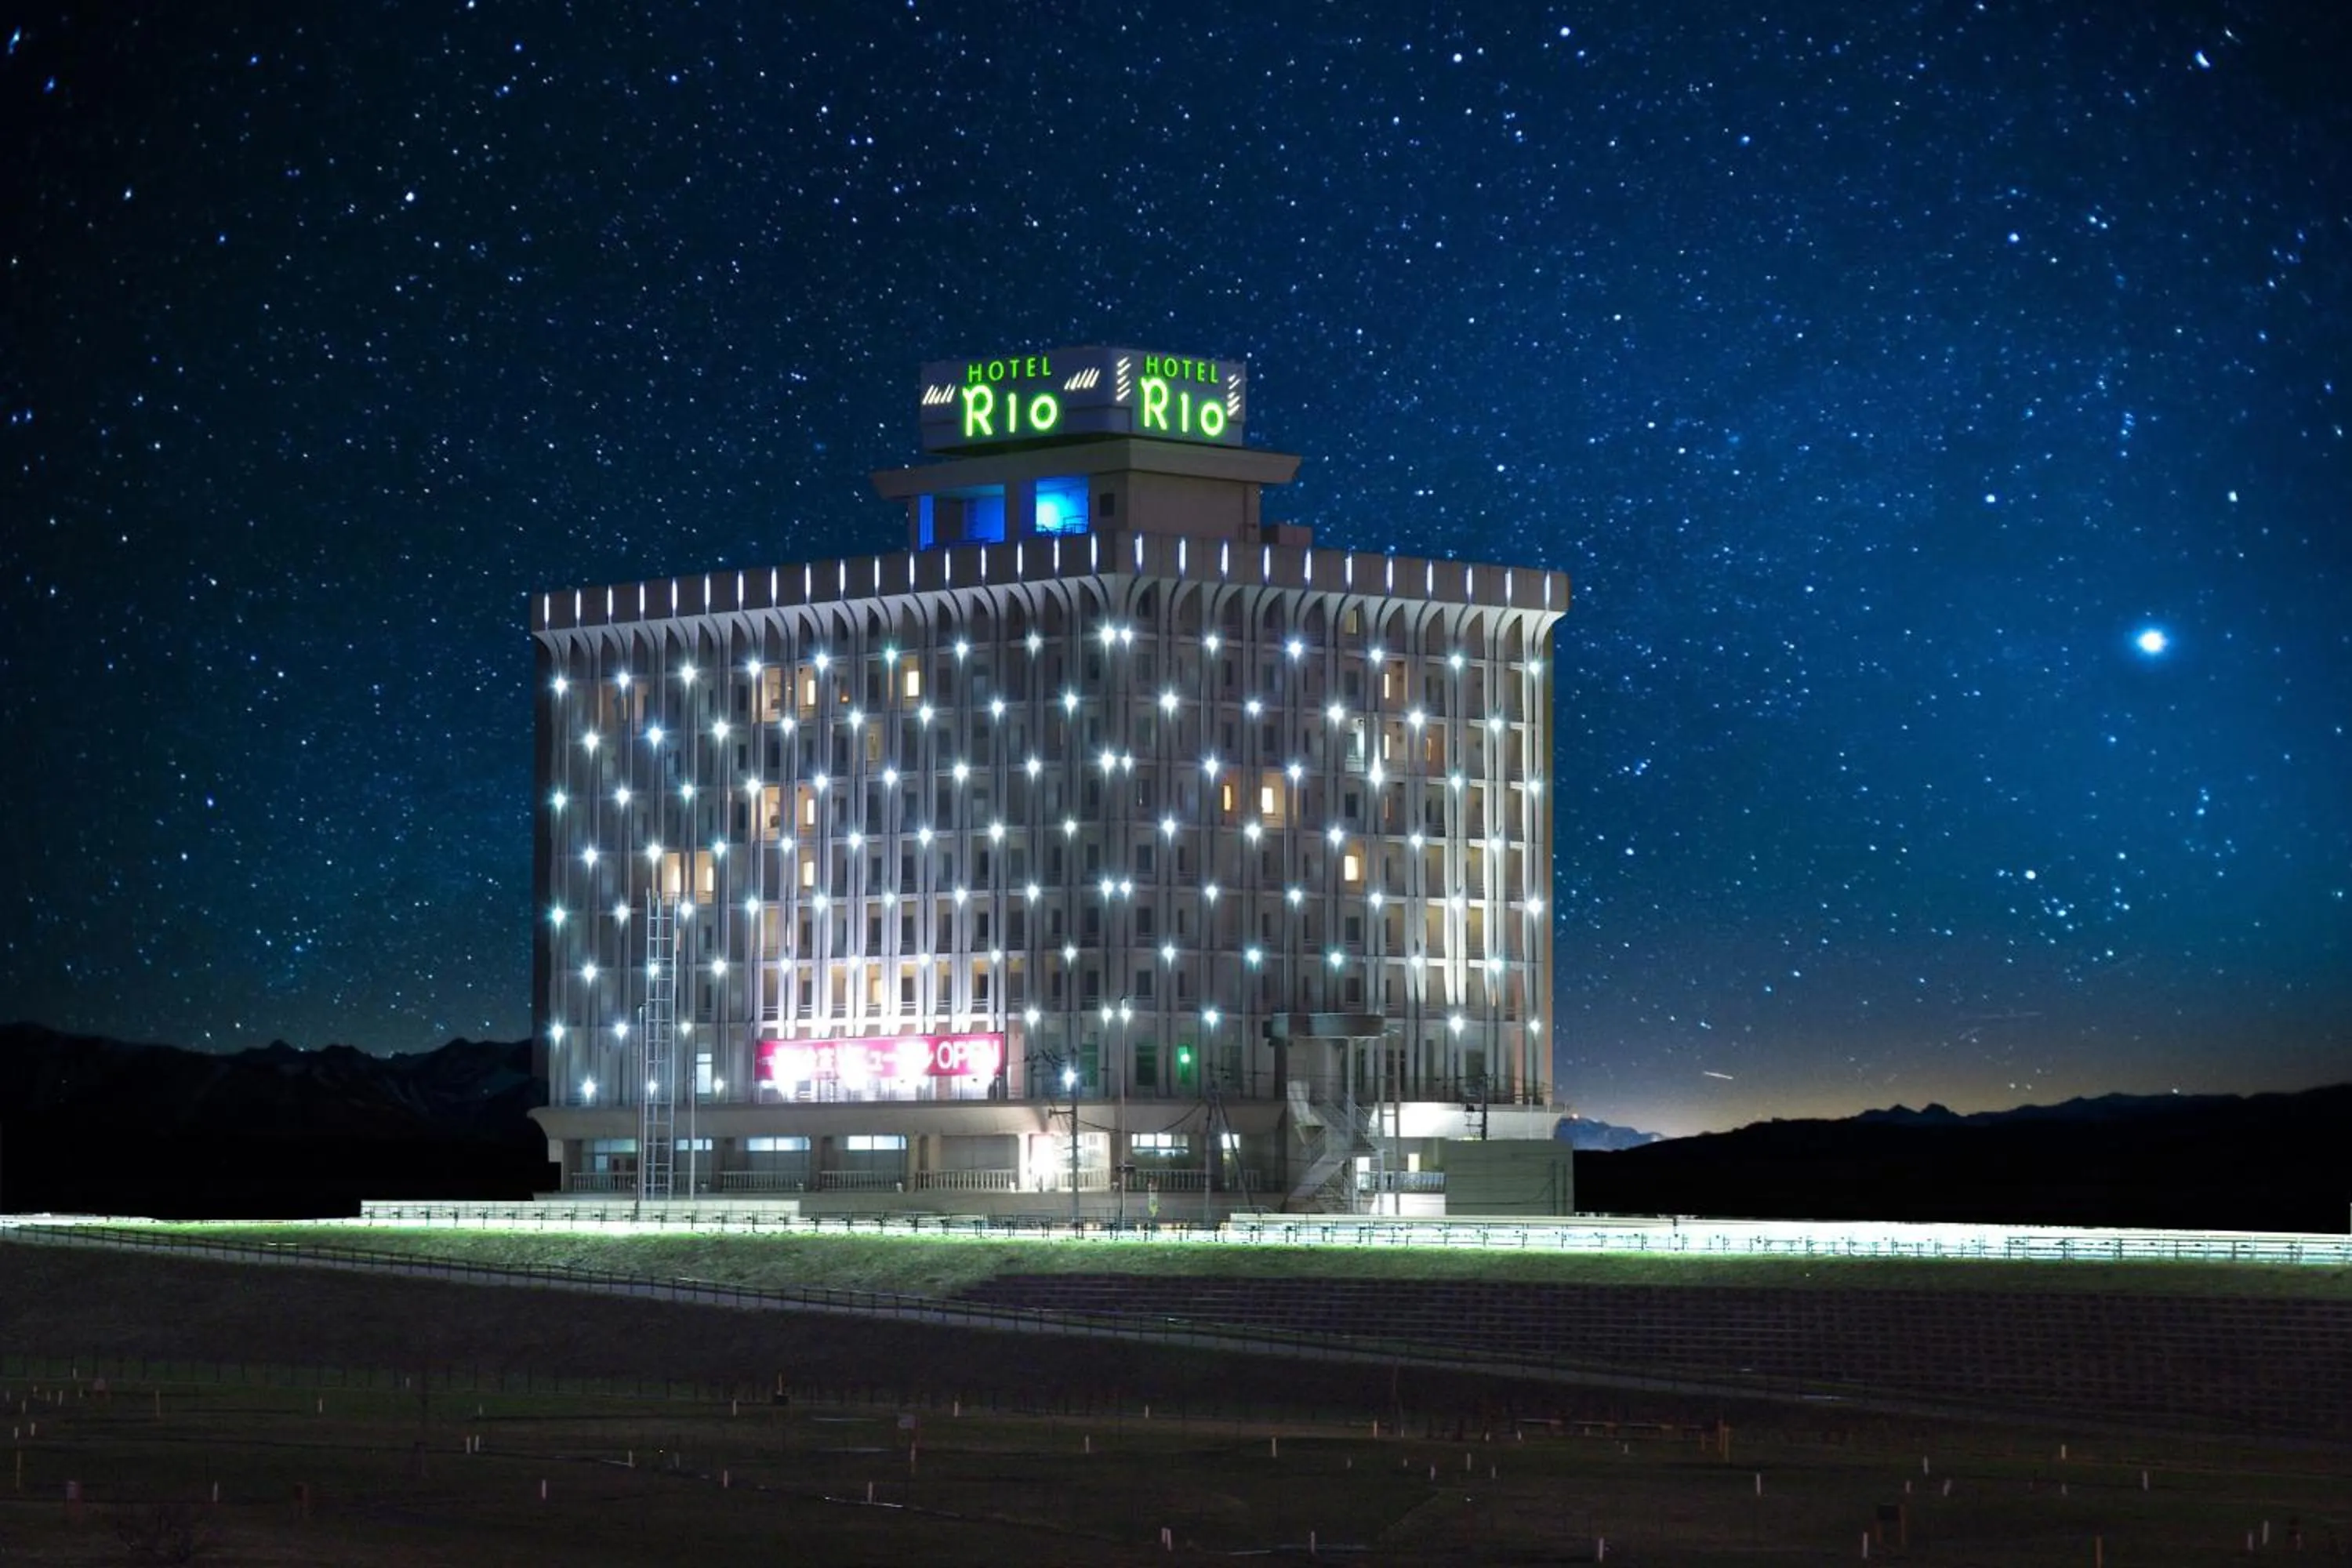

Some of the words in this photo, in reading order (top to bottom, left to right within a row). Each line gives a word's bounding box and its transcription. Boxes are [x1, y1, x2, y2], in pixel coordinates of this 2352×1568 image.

[968, 356, 1052, 383] HOTEL
[1145, 354, 1219, 383] HOTEL
[937, 1040, 1000, 1070] OPN
